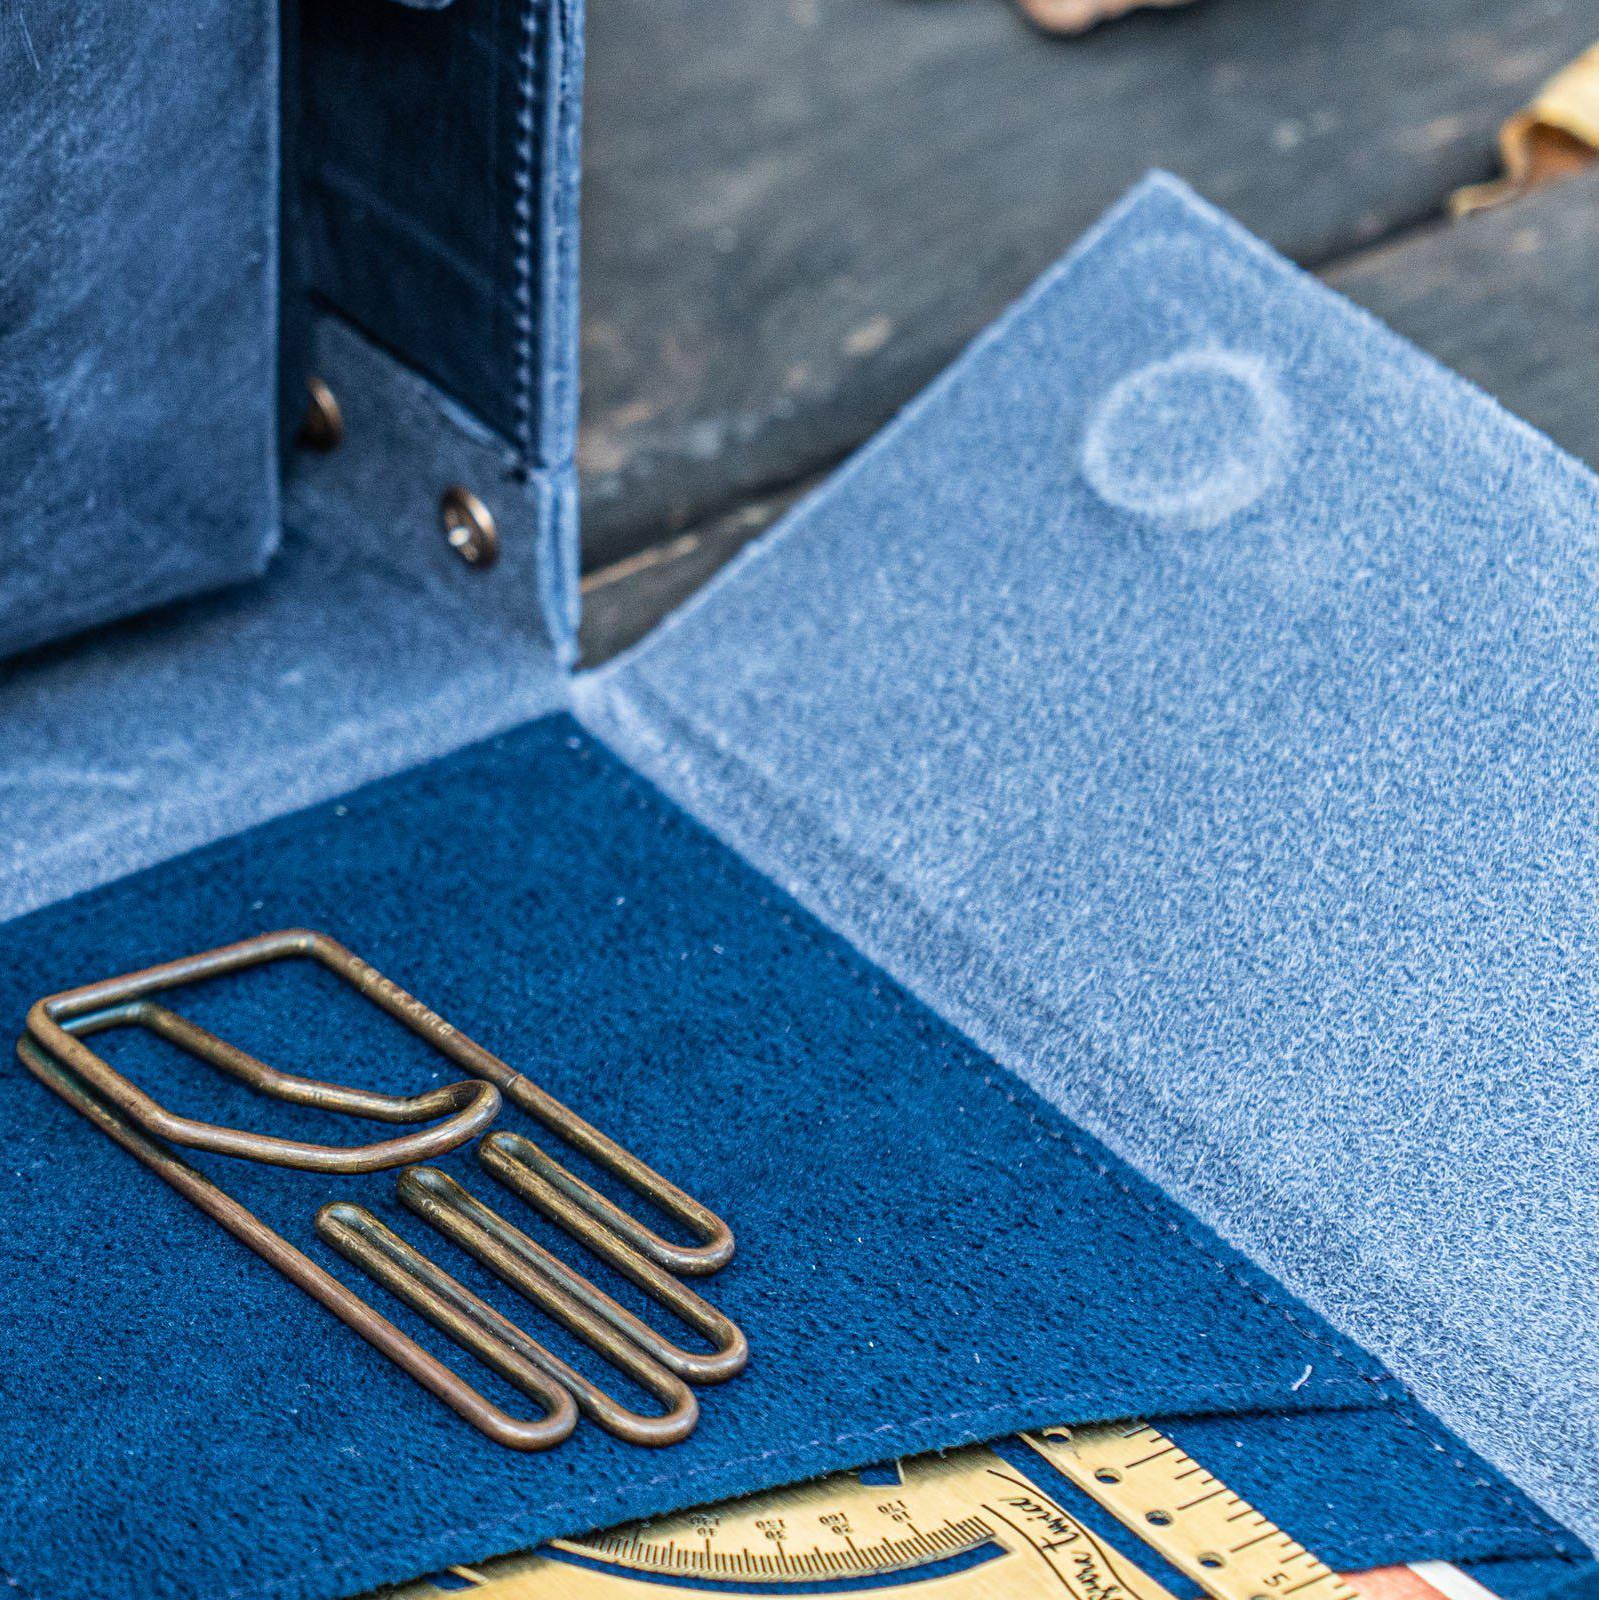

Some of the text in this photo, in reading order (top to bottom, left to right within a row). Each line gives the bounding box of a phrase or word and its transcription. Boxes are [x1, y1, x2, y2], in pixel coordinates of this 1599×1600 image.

[877, 1499, 908, 1514] 170
[818, 1512, 849, 1525] 160
[891, 1510, 912, 1523] 10
[831, 1523, 854, 1535] 20
